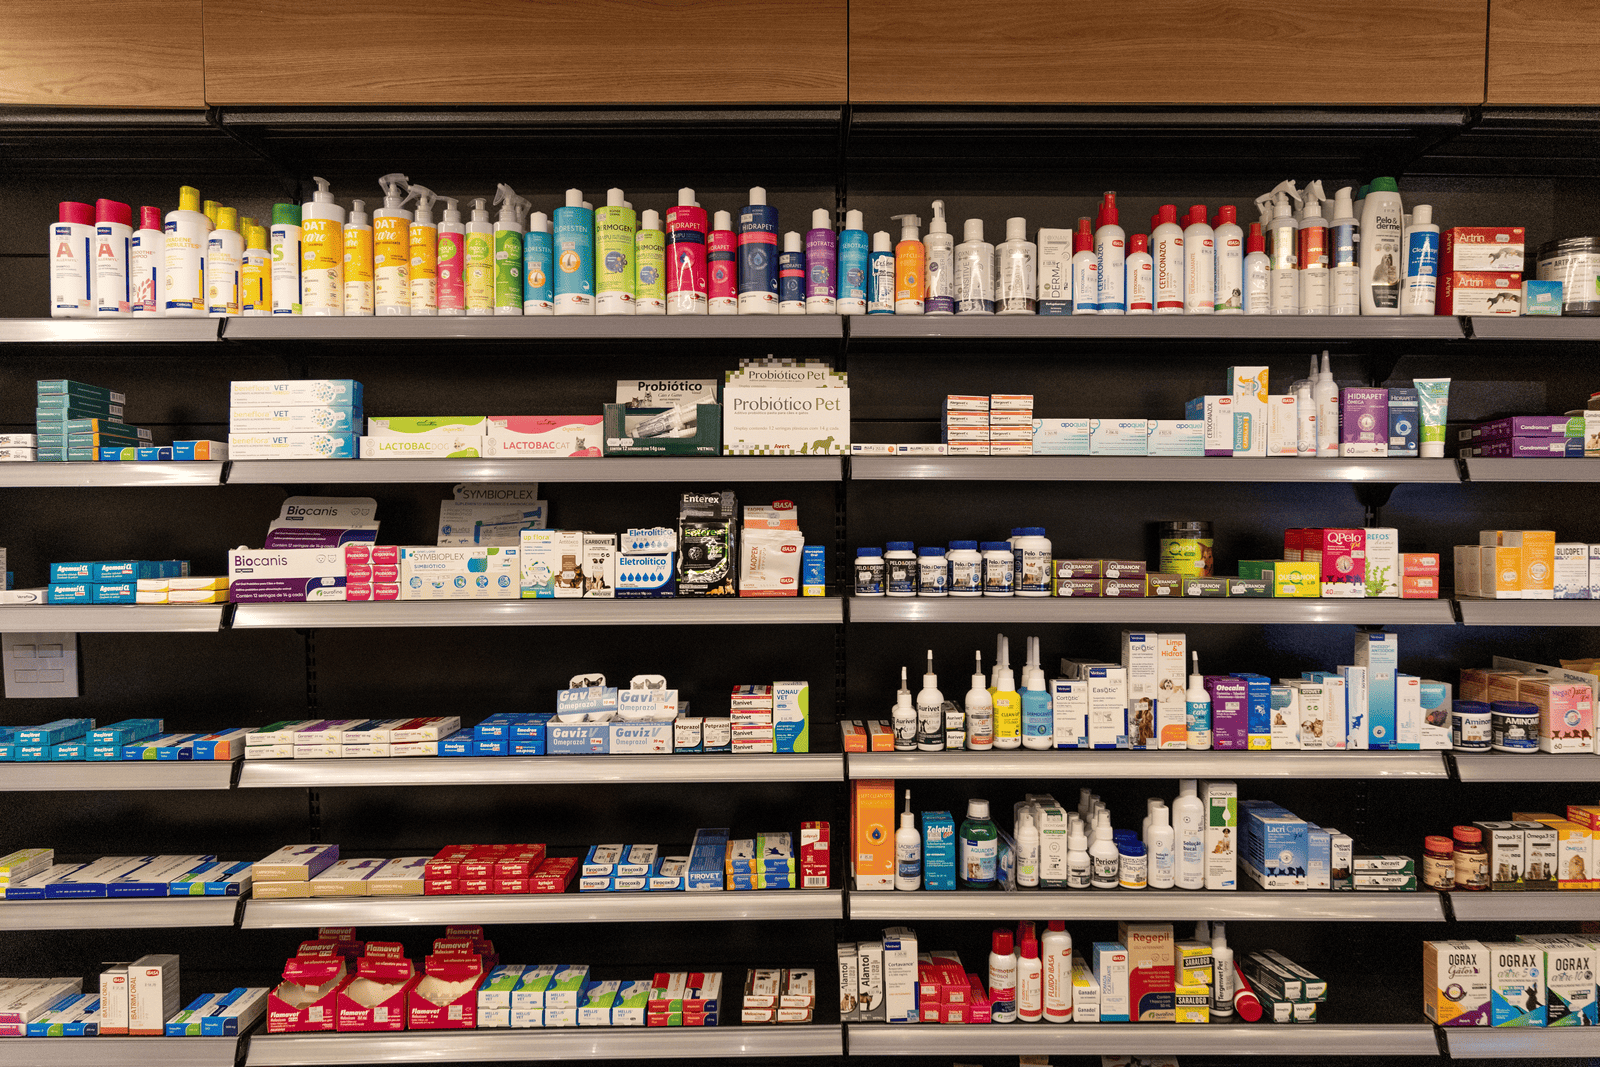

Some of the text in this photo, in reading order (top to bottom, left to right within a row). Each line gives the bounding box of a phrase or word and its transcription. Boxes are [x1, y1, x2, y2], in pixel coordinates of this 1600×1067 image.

[375, 219, 397, 229] OAT
[1376, 216, 1392, 224] Pelo
[303, 221, 326, 231] OAT
[1376, 223, 1400, 231] derme
[1459, 233, 1485, 243] Artrin
[56, 242, 74, 258] A
[98, 243, 115, 258] A
[1159, 239, 1167, 290] CETOCONAZOL
[1051, 260, 1061, 298] DERMA
[1458, 278, 1484, 288] Artrin
[748, 370, 825, 381] Probiótico Pet
[637, 380, 703, 392] Probiótico
[733, 397, 841, 411] Probiótico Pet
[1060, 421, 1088, 429] apoquel
[462, 490, 533, 500] SYMBIOPLEX
[683, 495, 720, 504] Enterex
[286, 505, 338, 516] Biocanis
[523, 534, 532, 542] up
[629, 529, 673, 537] Eletrolítico
[1327, 532, 1362, 545] QPelo
[1556, 547, 1584, 555] GLICOPET
[234, 555, 288, 567] Biocanis
[413, 552, 465, 561] SYMBIOPLEX
[619, 557, 667, 566] Eletrolítico
[750, 546, 758, 570] KAOPEK
[1109, 562, 1141, 570] QUERANON
[1166, 639, 1183, 647] Limp
[1216, 684, 1246, 692] Otocalm
[559, 700, 597, 710] Omeprazol
[619, 703, 657, 712] Omeprazol
[705, 722, 729, 730] Petprazol
[552, 727, 600, 739] Gaviz V
[615, 727, 663, 738] Gaviz V
[553, 738, 586, 747] Omeprazol
[615, 738, 648, 746] Omeprazol
[926, 825, 953, 833] Zelotril
[1267, 825, 1305, 834] Lacri Caps
[319, 928, 352, 936] Flamavet
[1132, 932, 1170, 944] Regepil
[299, 943, 334, 952] Flamavet
[366, 944, 401, 953] Flamavet
[434, 941, 470, 950] Flamavet
[1184, 956, 1210, 967] SARALOGO
[1448, 954, 1477, 966] OGRAX
[1499, 954, 1537, 967] OGRAX
[1555, 957, 1590, 971] OGRAX
[861, 954, 870, 987] Alantol
[1447, 965, 1474, 980] Gatos
[1522, 967, 1529, 977] 5
[1574, 971, 1583, 981] 10
[1178, 996, 1207, 1004] SARALOGO
[270, 1011, 300, 1019] Flamavet
[340, 1009, 370, 1017] Flamavet
